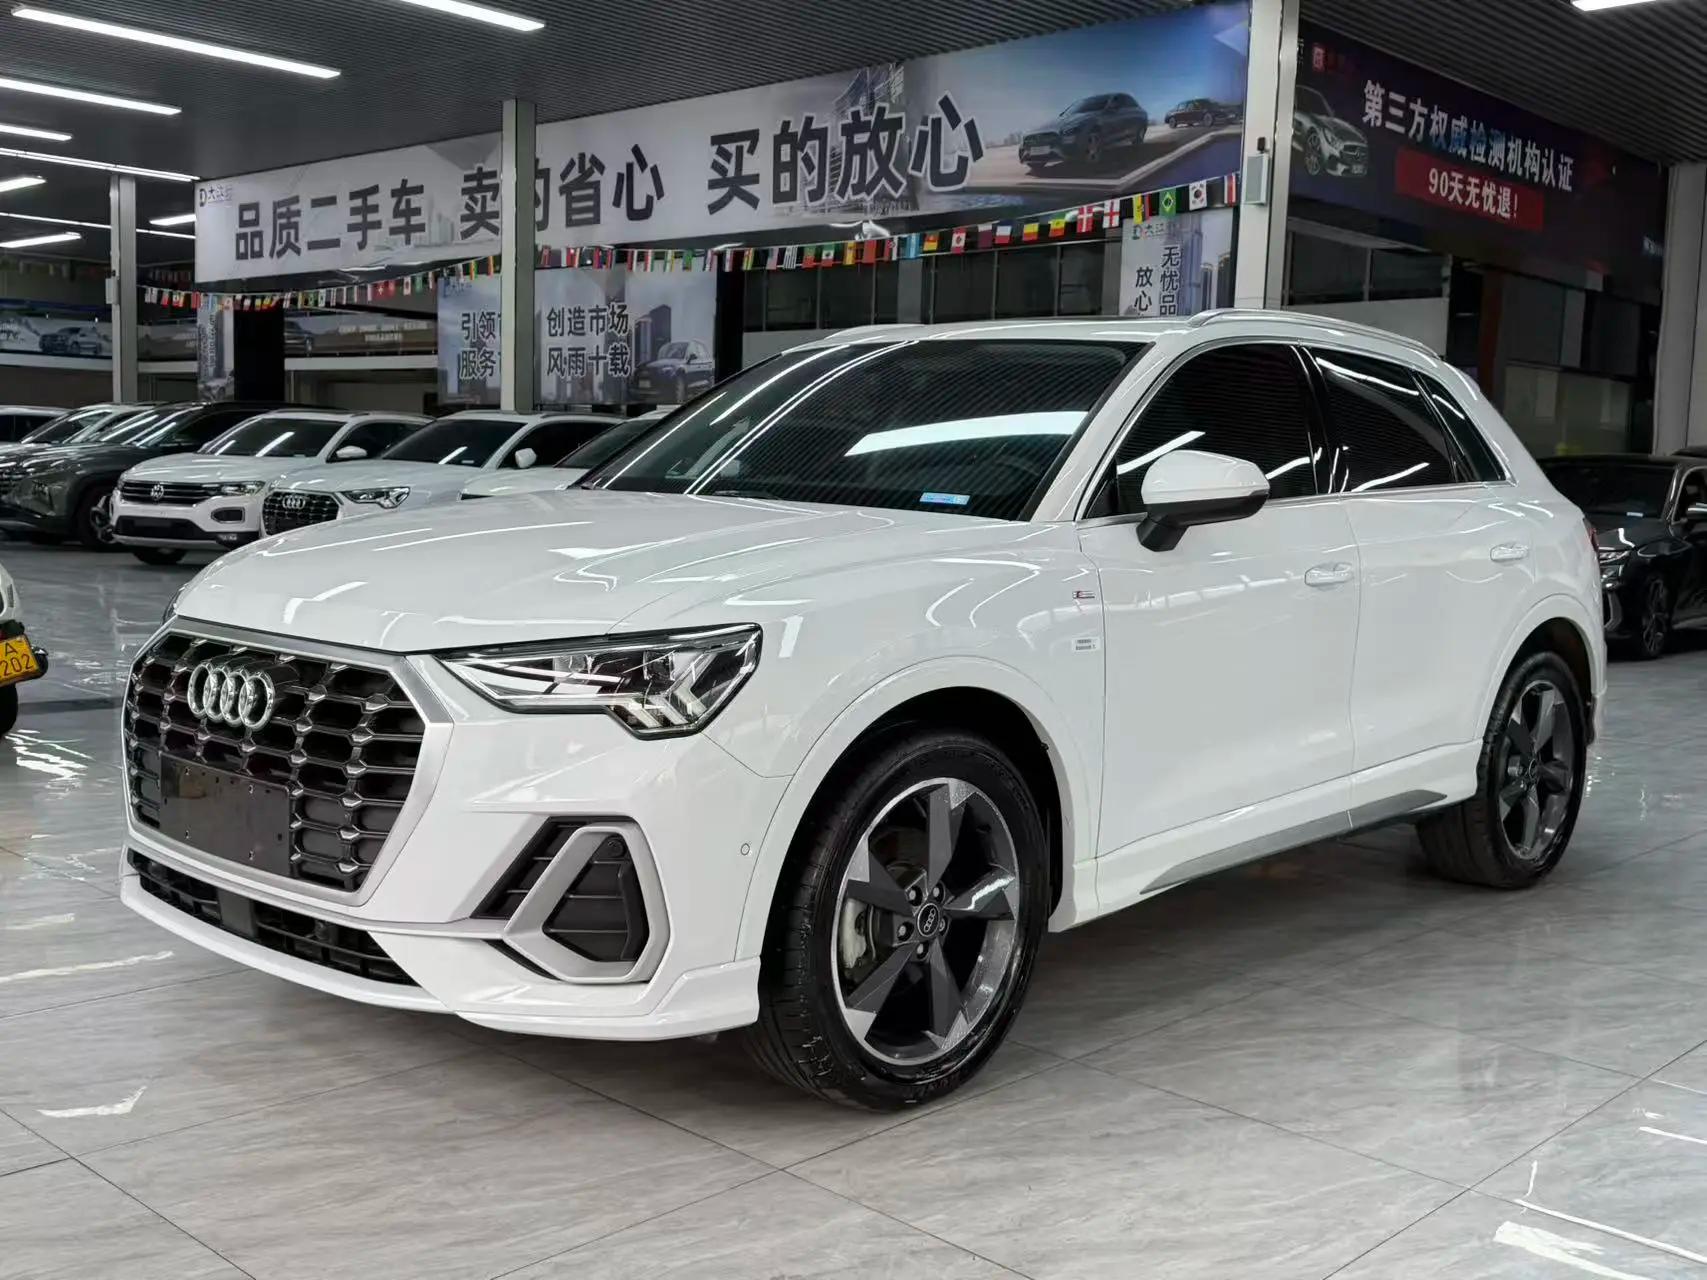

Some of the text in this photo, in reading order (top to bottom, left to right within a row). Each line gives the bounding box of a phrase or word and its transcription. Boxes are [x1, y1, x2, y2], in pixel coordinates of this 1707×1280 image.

[1362, 79, 1574, 192] 第三方权威检测机构认证
[235, 178, 426, 261] 品质二手车
[707, 93, 984, 216] 买的放心
[1134, 266, 1154, 316] 放心
[461, 311, 501, 340] 引领
[546, 303, 629, 337] 创造市场
[460, 346, 630, 377] 服务 风雨十载
